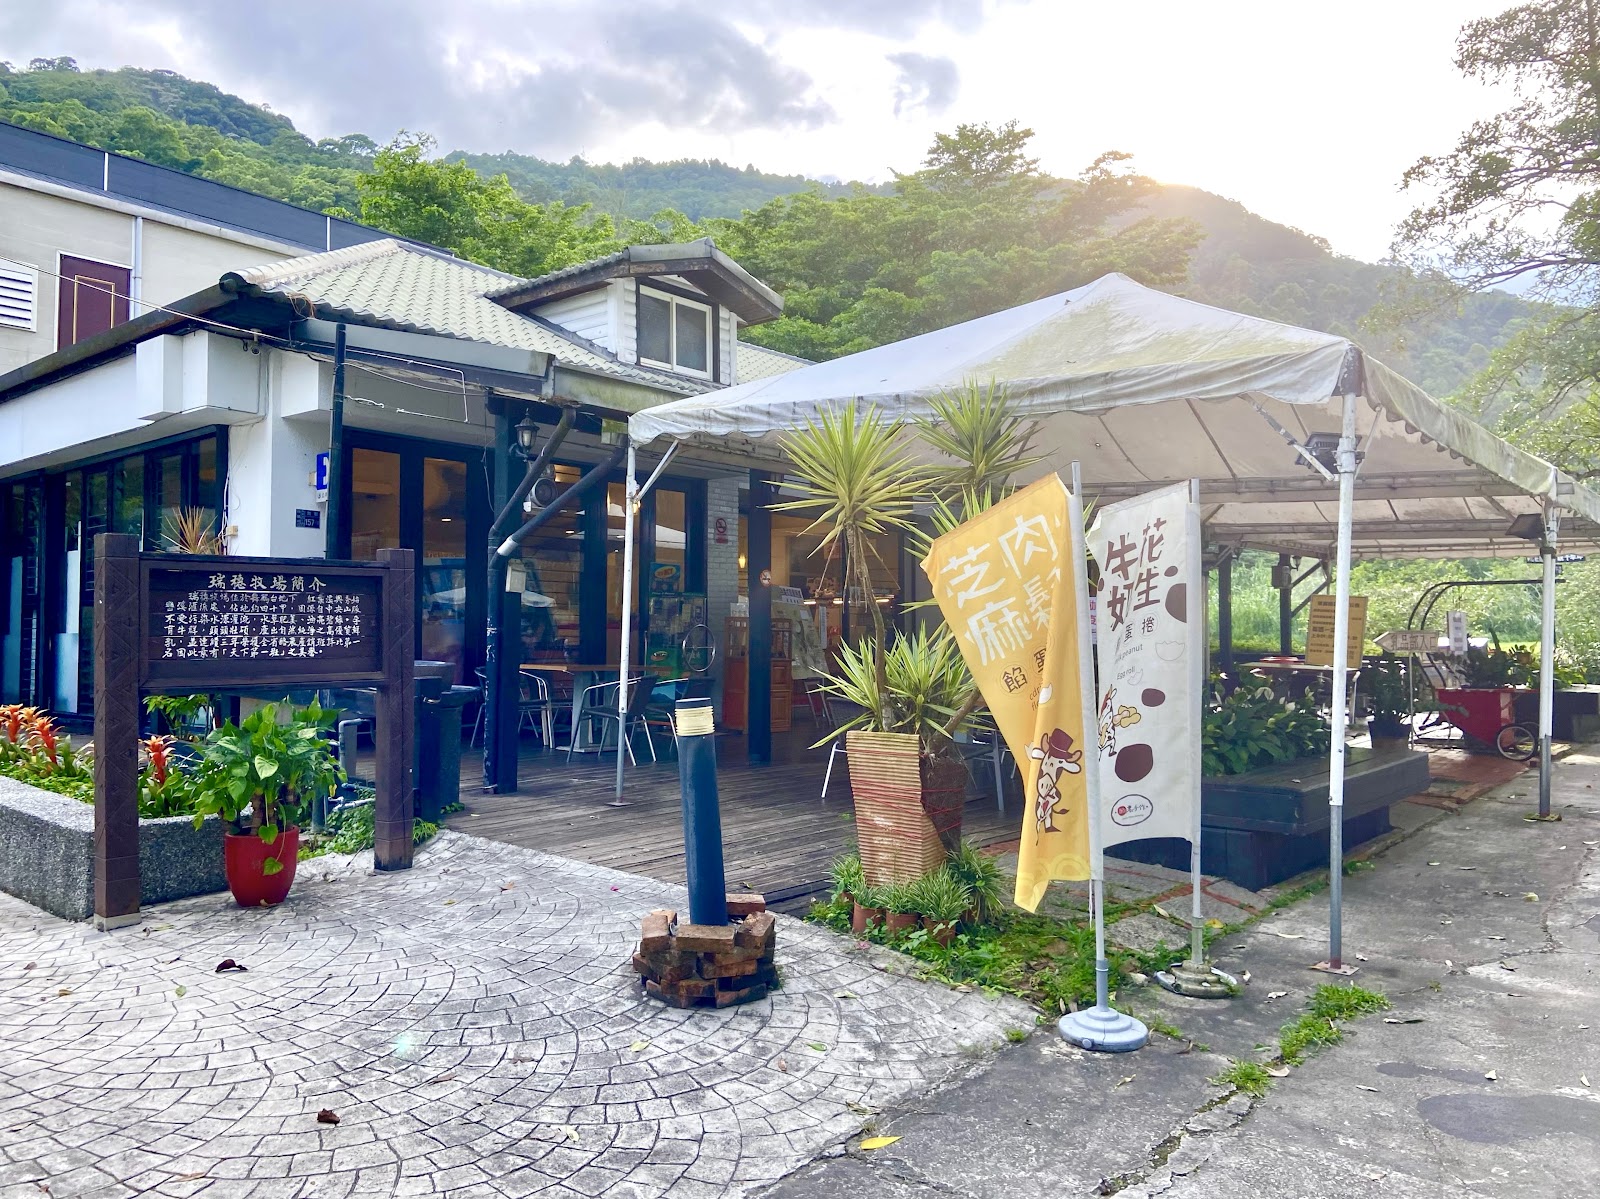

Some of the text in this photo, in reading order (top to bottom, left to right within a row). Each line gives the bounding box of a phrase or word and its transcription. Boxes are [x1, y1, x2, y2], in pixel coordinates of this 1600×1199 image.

[305, 518, 315, 527] 157
[208, 573, 327, 592] 瑞穗牧場簡介
[1133, 517, 1167, 612] 花生
[940, 542, 1033, 667] 芝麻
